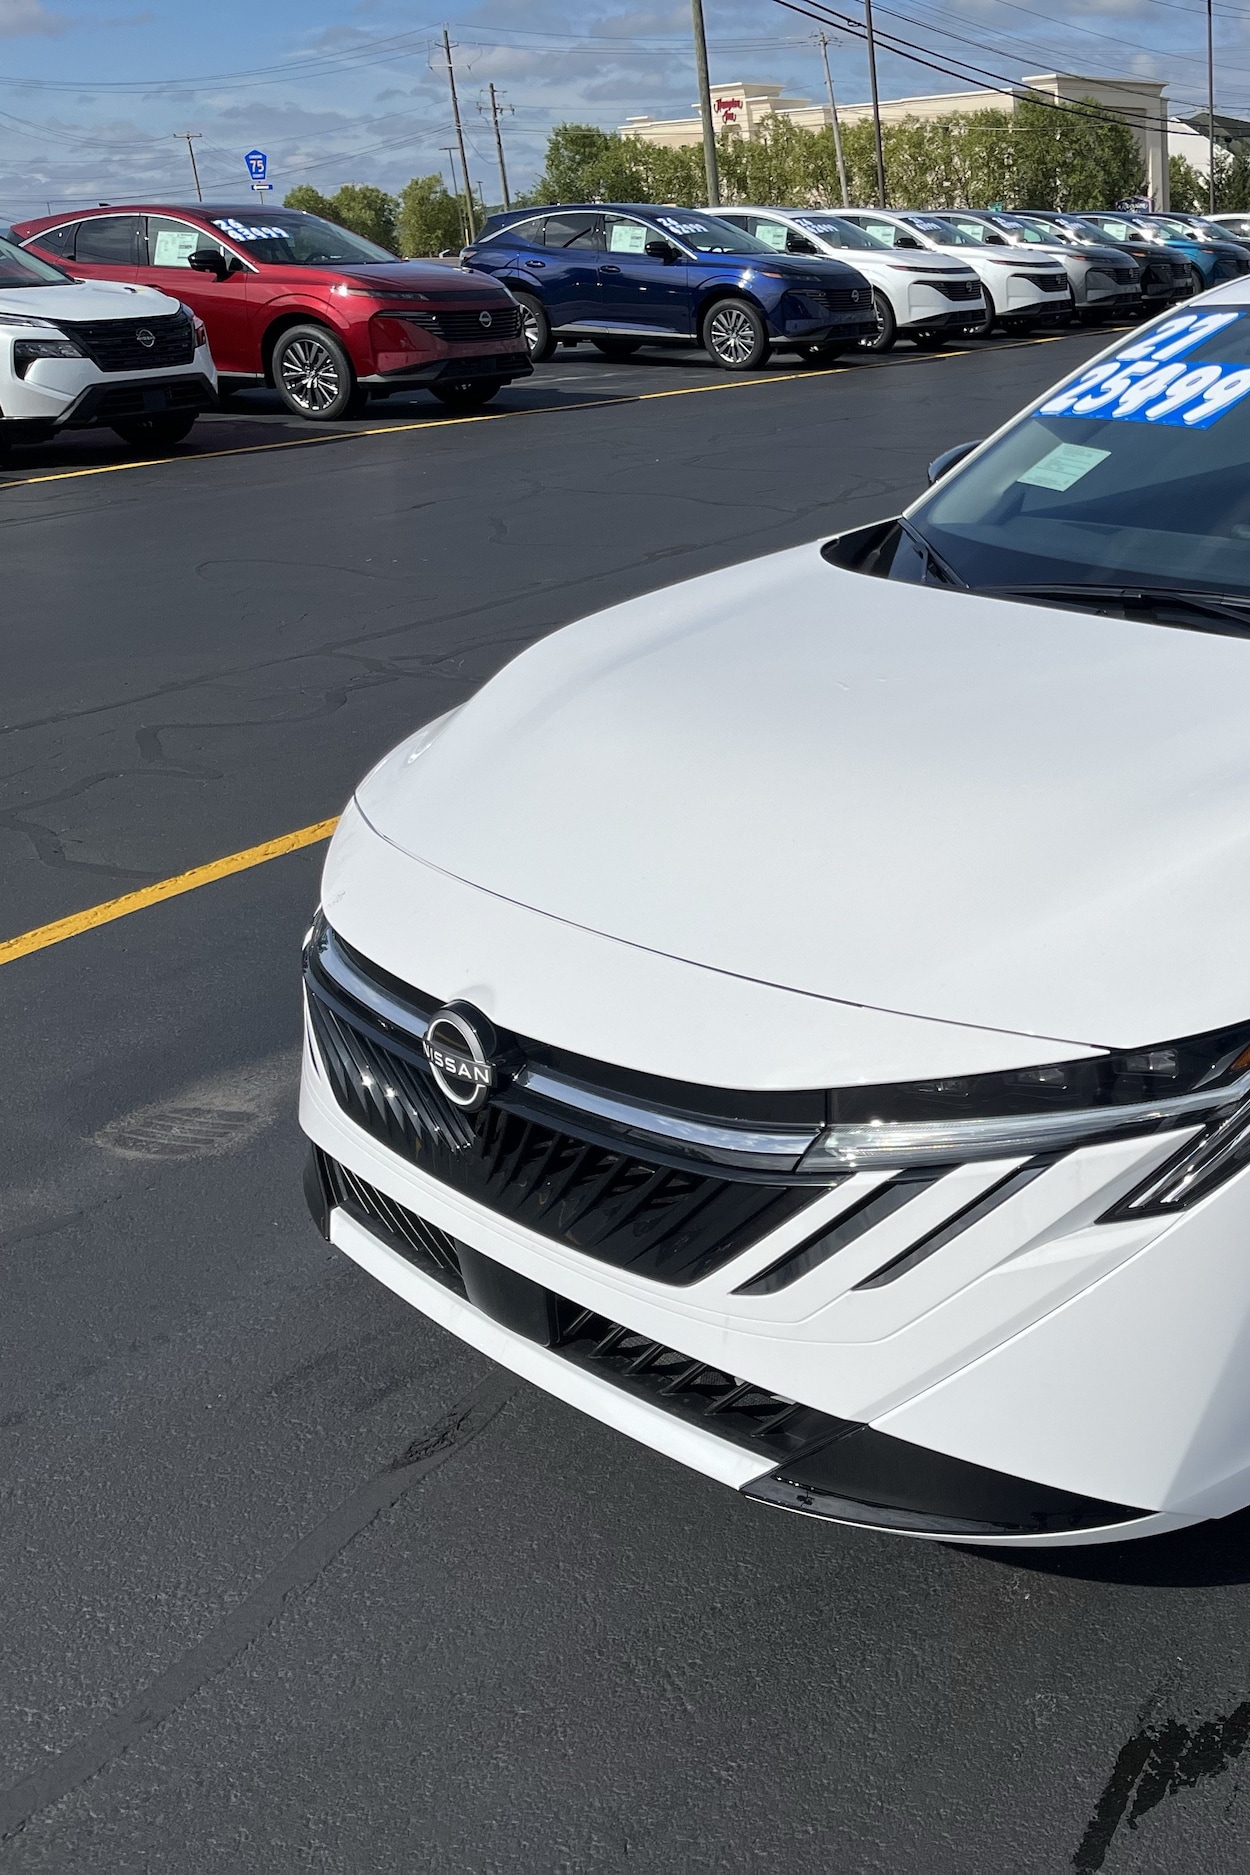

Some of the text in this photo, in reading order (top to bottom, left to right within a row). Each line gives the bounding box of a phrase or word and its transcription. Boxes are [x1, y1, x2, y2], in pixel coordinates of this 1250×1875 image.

[250, 160, 264, 172] 75
[1116, 312, 1239, 361] 27
[422, 1041, 490, 1083] NISSAN
